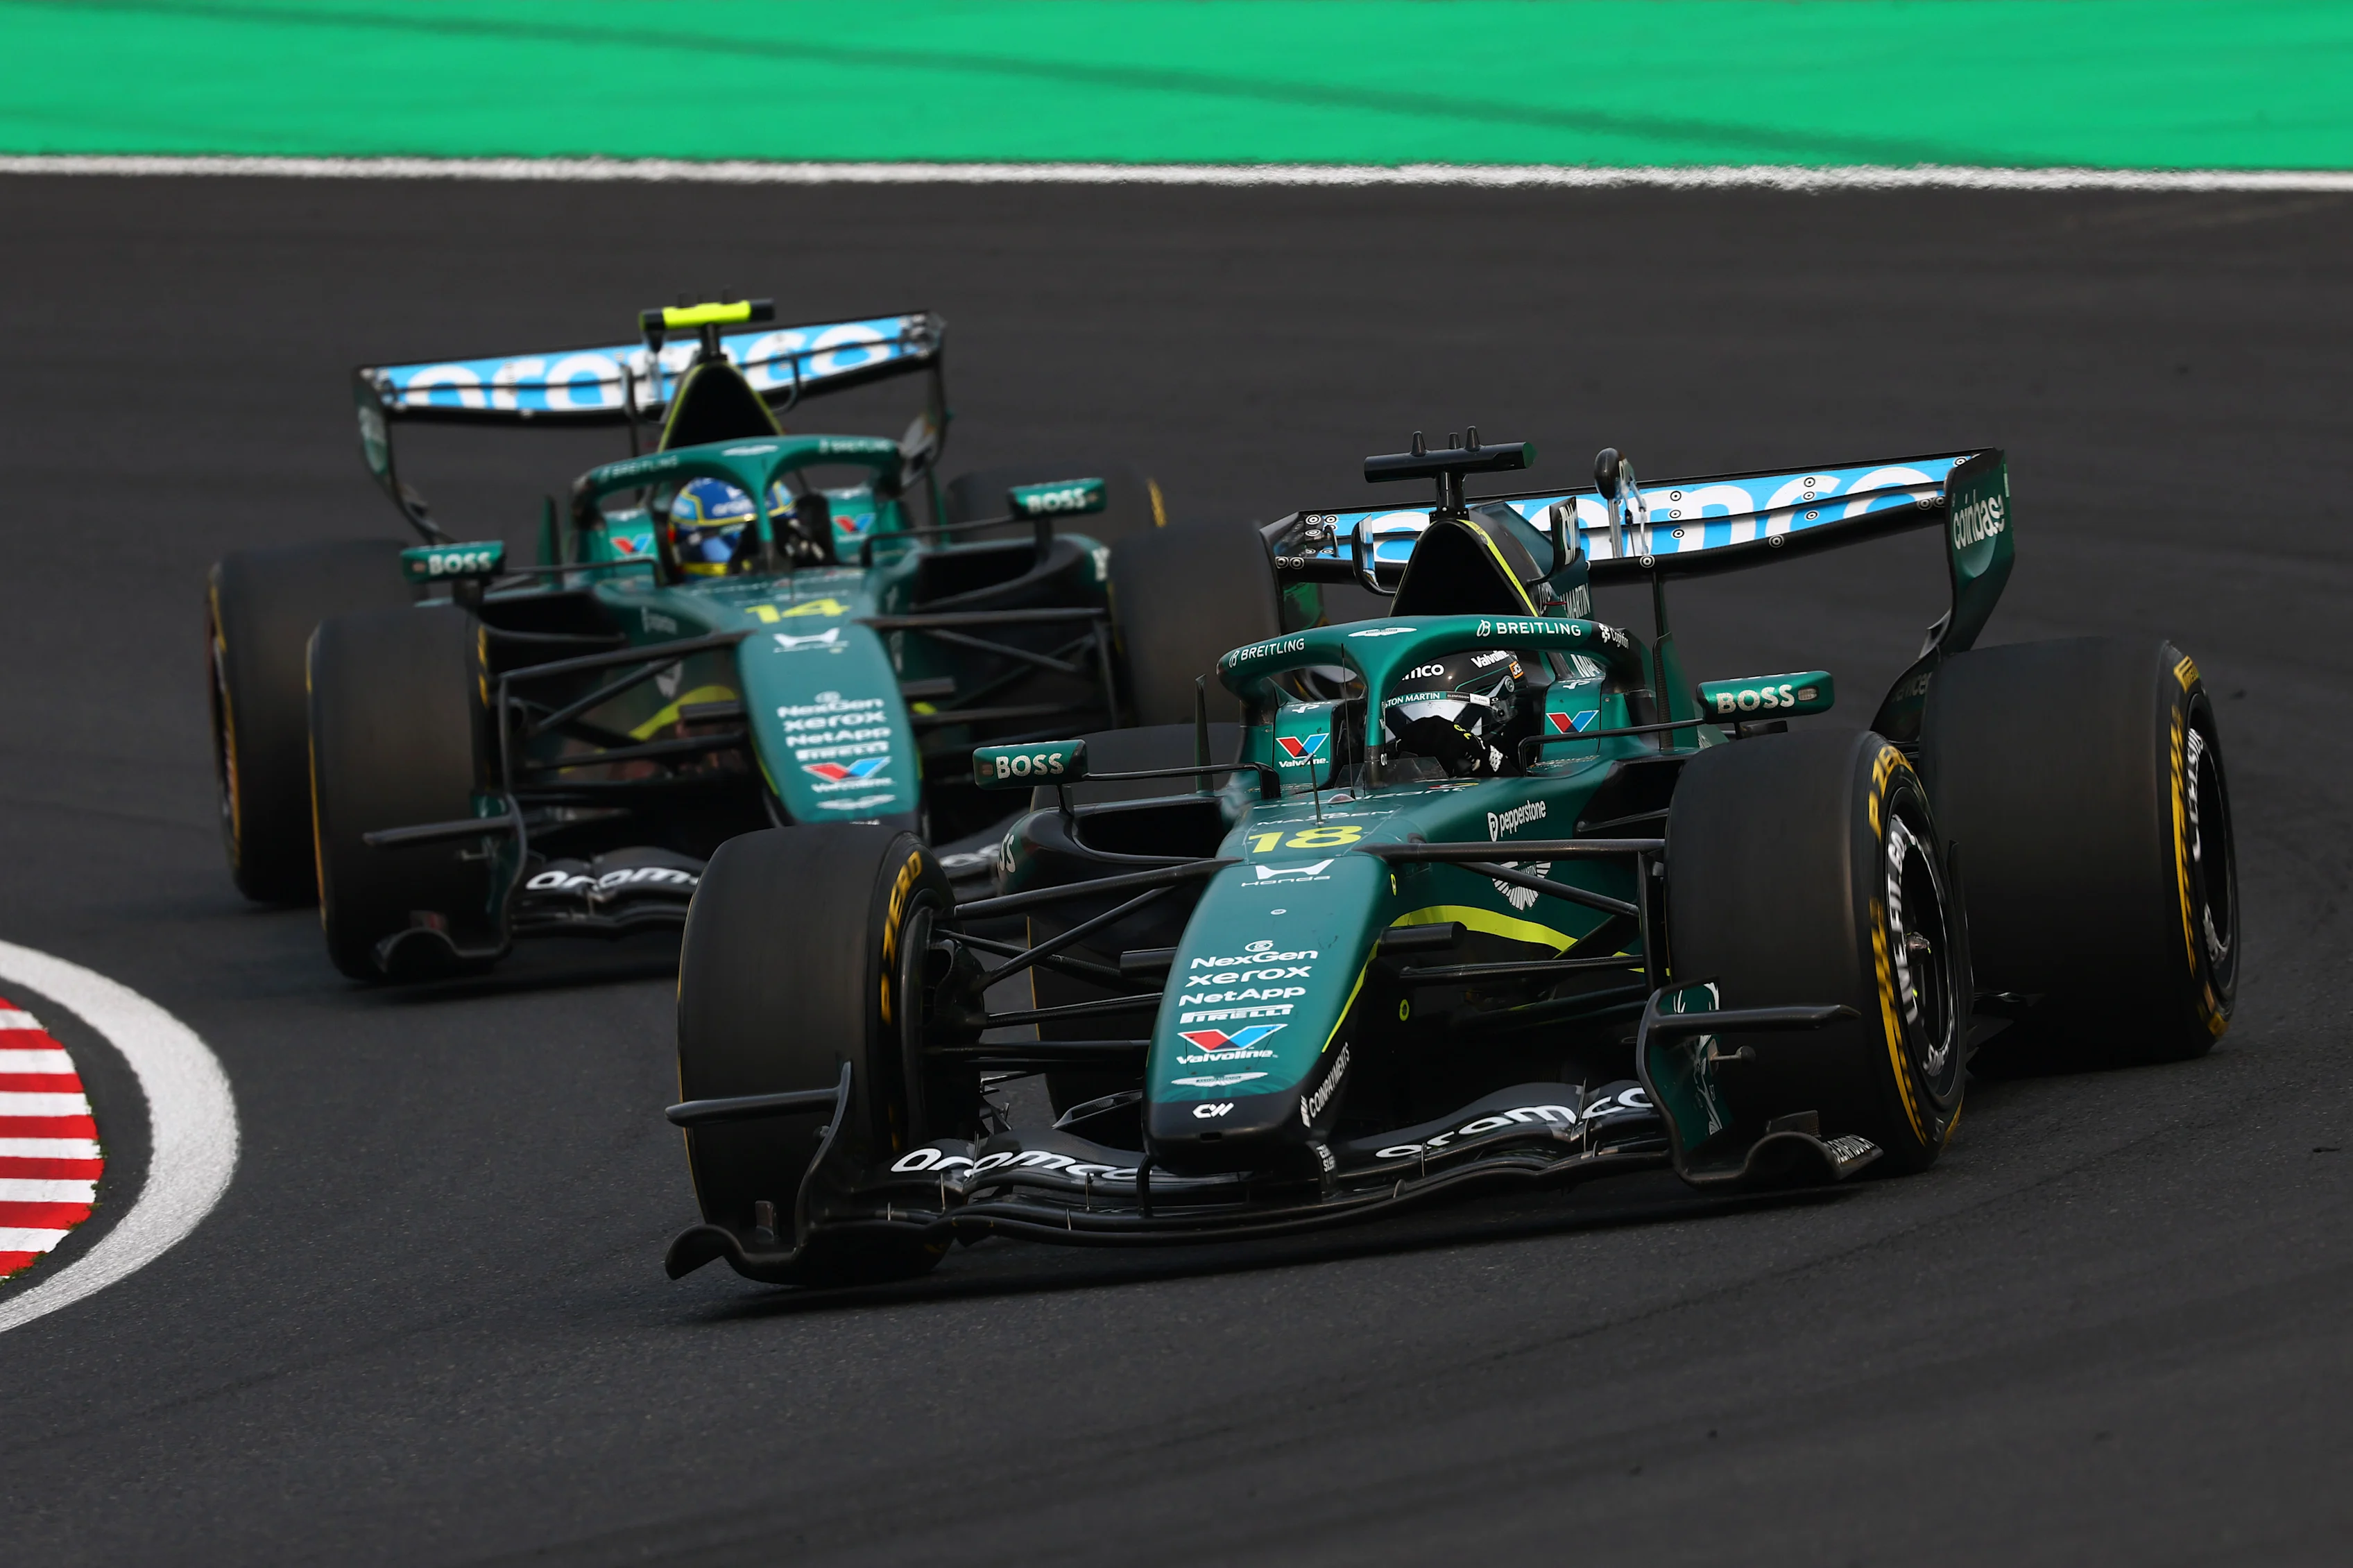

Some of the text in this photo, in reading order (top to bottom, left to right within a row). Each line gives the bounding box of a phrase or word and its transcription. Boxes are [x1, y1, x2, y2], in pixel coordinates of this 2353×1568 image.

[1026, 488, 1086, 514] BOSS
[1953, 489, 2005, 549] coinbase
[429, 552, 492, 575] BOSS
[744, 598, 851, 623] 14
[1496, 622, 1581, 636] BREITLING
[1240, 638, 1305, 661] BREITLING
[776, 698, 884, 718] NexGen
[1405, 693, 1440, 703] MARTIN
[1715, 684, 1795, 714] BOSS
[783, 710, 888, 732] xerox
[785, 727, 891, 748] NetApp
[995, 752, 1064, 779] BOSS
[1499, 800, 1546, 837] pepperstone
[1249, 825, 1362, 854] 18
[526, 867, 701, 891] aram
[1190, 950, 1318, 969] NexGen
[1185, 966, 1312, 988] xerox
[1179, 986, 1306, 1006] NetApp
[1179, 1003, 1294, 1024] PIRELLI
[1176, 1049, 1274, 1065] Valvoline
[1309, 1042, 1350, 1119] COINPAYMENTS
[890, 1148, 1152, 1179] aramco
